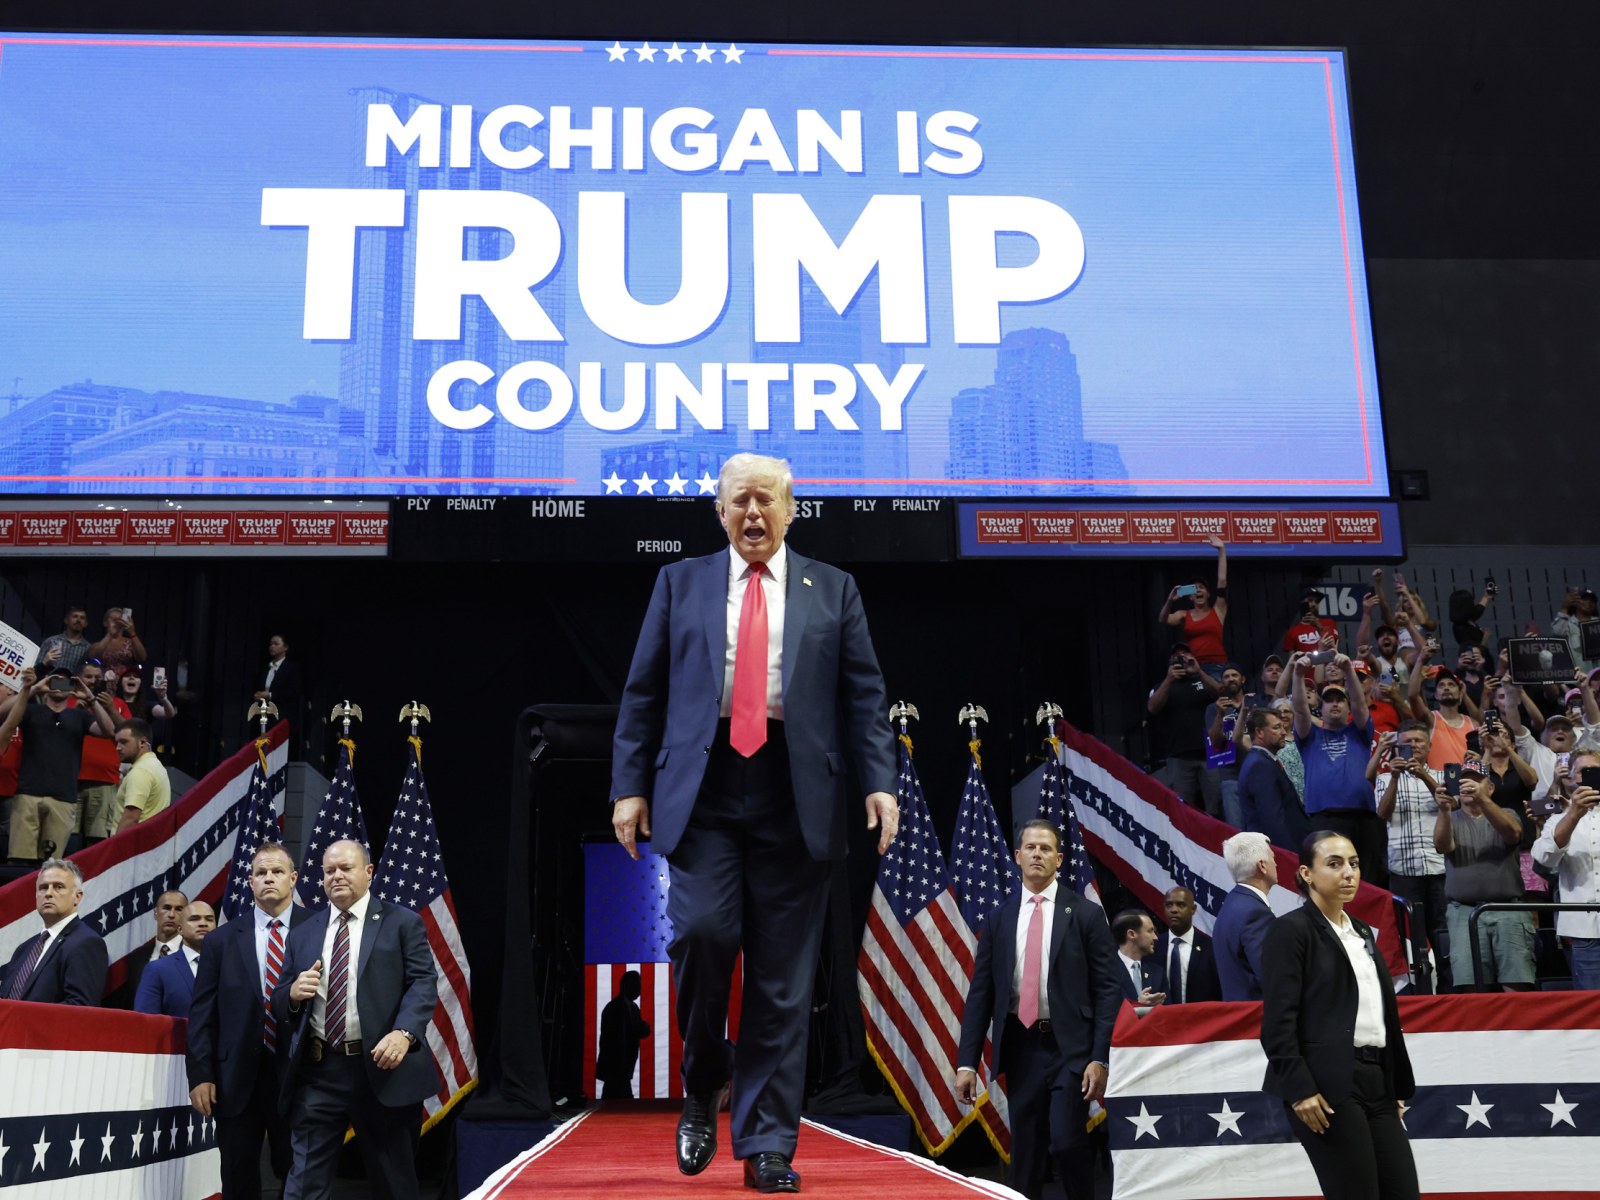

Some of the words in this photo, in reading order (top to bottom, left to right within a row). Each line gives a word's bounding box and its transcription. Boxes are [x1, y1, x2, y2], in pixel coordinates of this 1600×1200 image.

[366, 104, 863, 172] MICHIGAN
[897, 110, 984, 175] IS
[261, 187, 1086, 346] TRUMP
[426, 360, 926, 431] COUNTRY
[407, 499, 431, 511] PLY
[447, 498, 497, 511] PENALTY
[854, 500, 877, 512] PLY
[893, 499, 941, 512] PENALTY
[531, 500, 586, 518] HOME
[22, 518, 68, 528] TRUMP
[76, 518, 122, 528] TRUMP
[130, 518, 176, 528] TRUMP
[184, 518, 230, 528] TRUMP
[237, 518, 282, 528] TRUMP
[290, 518, 336, 528] TRUMP
[343, 518, 388, 528] TRUMP
[979, 518, 1024, 526] TRUMP
[1031, 518, 1074, 526] TRUMP
[1081, 518, 1126, 526] TRUMP
[1132, 518, 1176, 526] TRUMP
[1183, 518, 1226, 526] TRUMP
[1233, 518, 1276, 526] TRUMP
[1284, 518, 1326, 526] TRUMP
[1334, 518, 1376, 526] TRUMP
[25, 526, 62, 534] VANCE
[80, 526, 116, 534] VANCE
[134, 526, 170, 534] VANCE
[188, 526, 224, 534] VANCE
[242, 526, 278, 534] VANCE
[295, 526, 330, 534] VANCE
[348, 526, 384, 534] VANCE
[985, 526, 1020, 534] VANCE
[1036, 526, 1070, 534] VANCE
[1086, 526, 1122, 534] VANCE
[1137, 526, 1172, 534] VANCE
[1188, 526, 1222, 534] VANCE
[1239, 526, 1274, 534] VANCE
[1289, 526, 1324, 534] VANCE
[1340, 526, 1374, 534] VANCE
[637, 540, 682, 553] PERIOD
[1316, 587, 1358, 616] 116
[1519, 643, 1564, 655] NEVER
